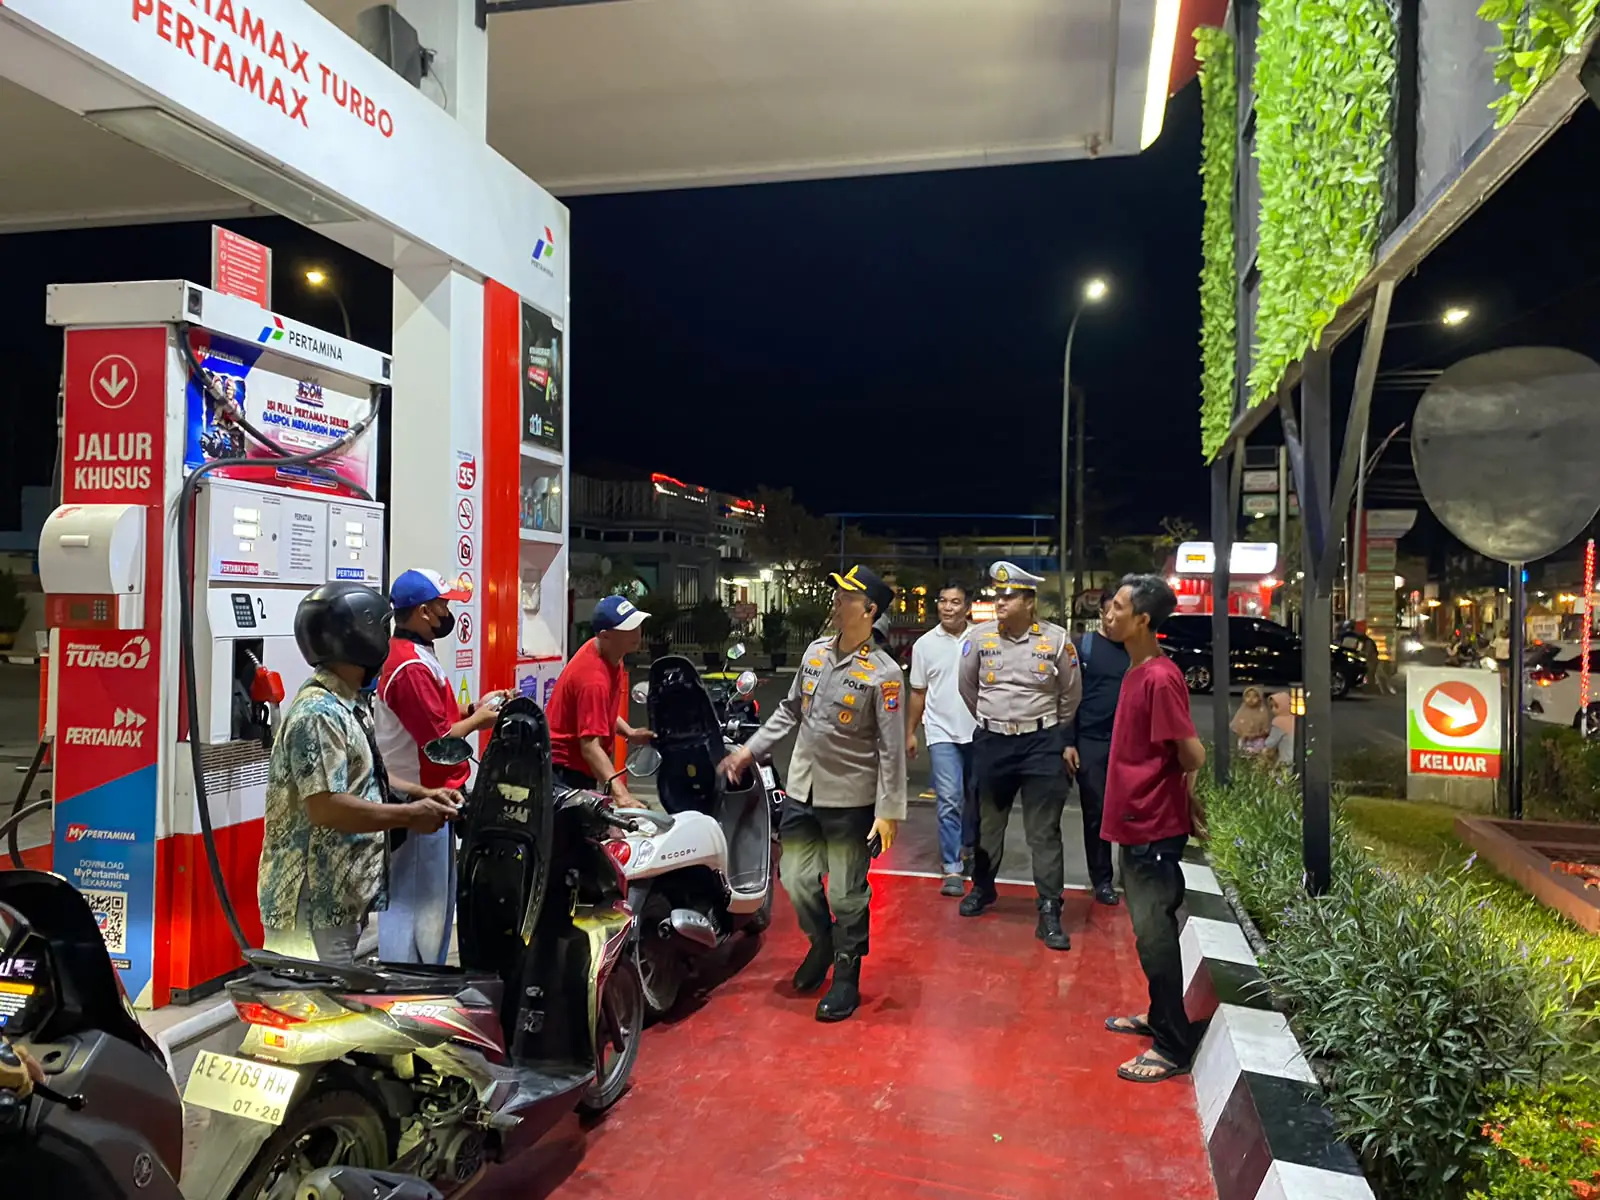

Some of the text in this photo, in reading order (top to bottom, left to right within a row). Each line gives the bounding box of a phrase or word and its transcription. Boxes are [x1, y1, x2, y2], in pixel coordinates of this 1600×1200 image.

[131, 0, 309, 129] PERTAMAX
[318, 62, 394, 138] TURBO
[288, 330, 343, 361] PERTAMINA
[263, 410, 290, 427] GASPOL
[267, 400, 349, 428] ISI FULL PERTAMAX SERIES
[74, 432, 152, 461] JALUR
[74, 466, 151, 490] KHUSUS
[337, 570, 364, 578] PERTAMAX
[257, 597, 267, 619] 2
[66, 651, 137, 669] TURBO
[843, 678, 869, 693] POLRI
[65, 726, 143, 748] PERTAMAX
[1420, 753, 1487, 773] KELUAR
[80, 859, 124, 870] DOWNLOAD
[660, 848, 697, 860] SCOOPY
[74, 867, 130, 881] MyPertamina
[80, 878, 122, 889] SEKARANG
[195, 1054, 288, 1096] AE 2769 HW
